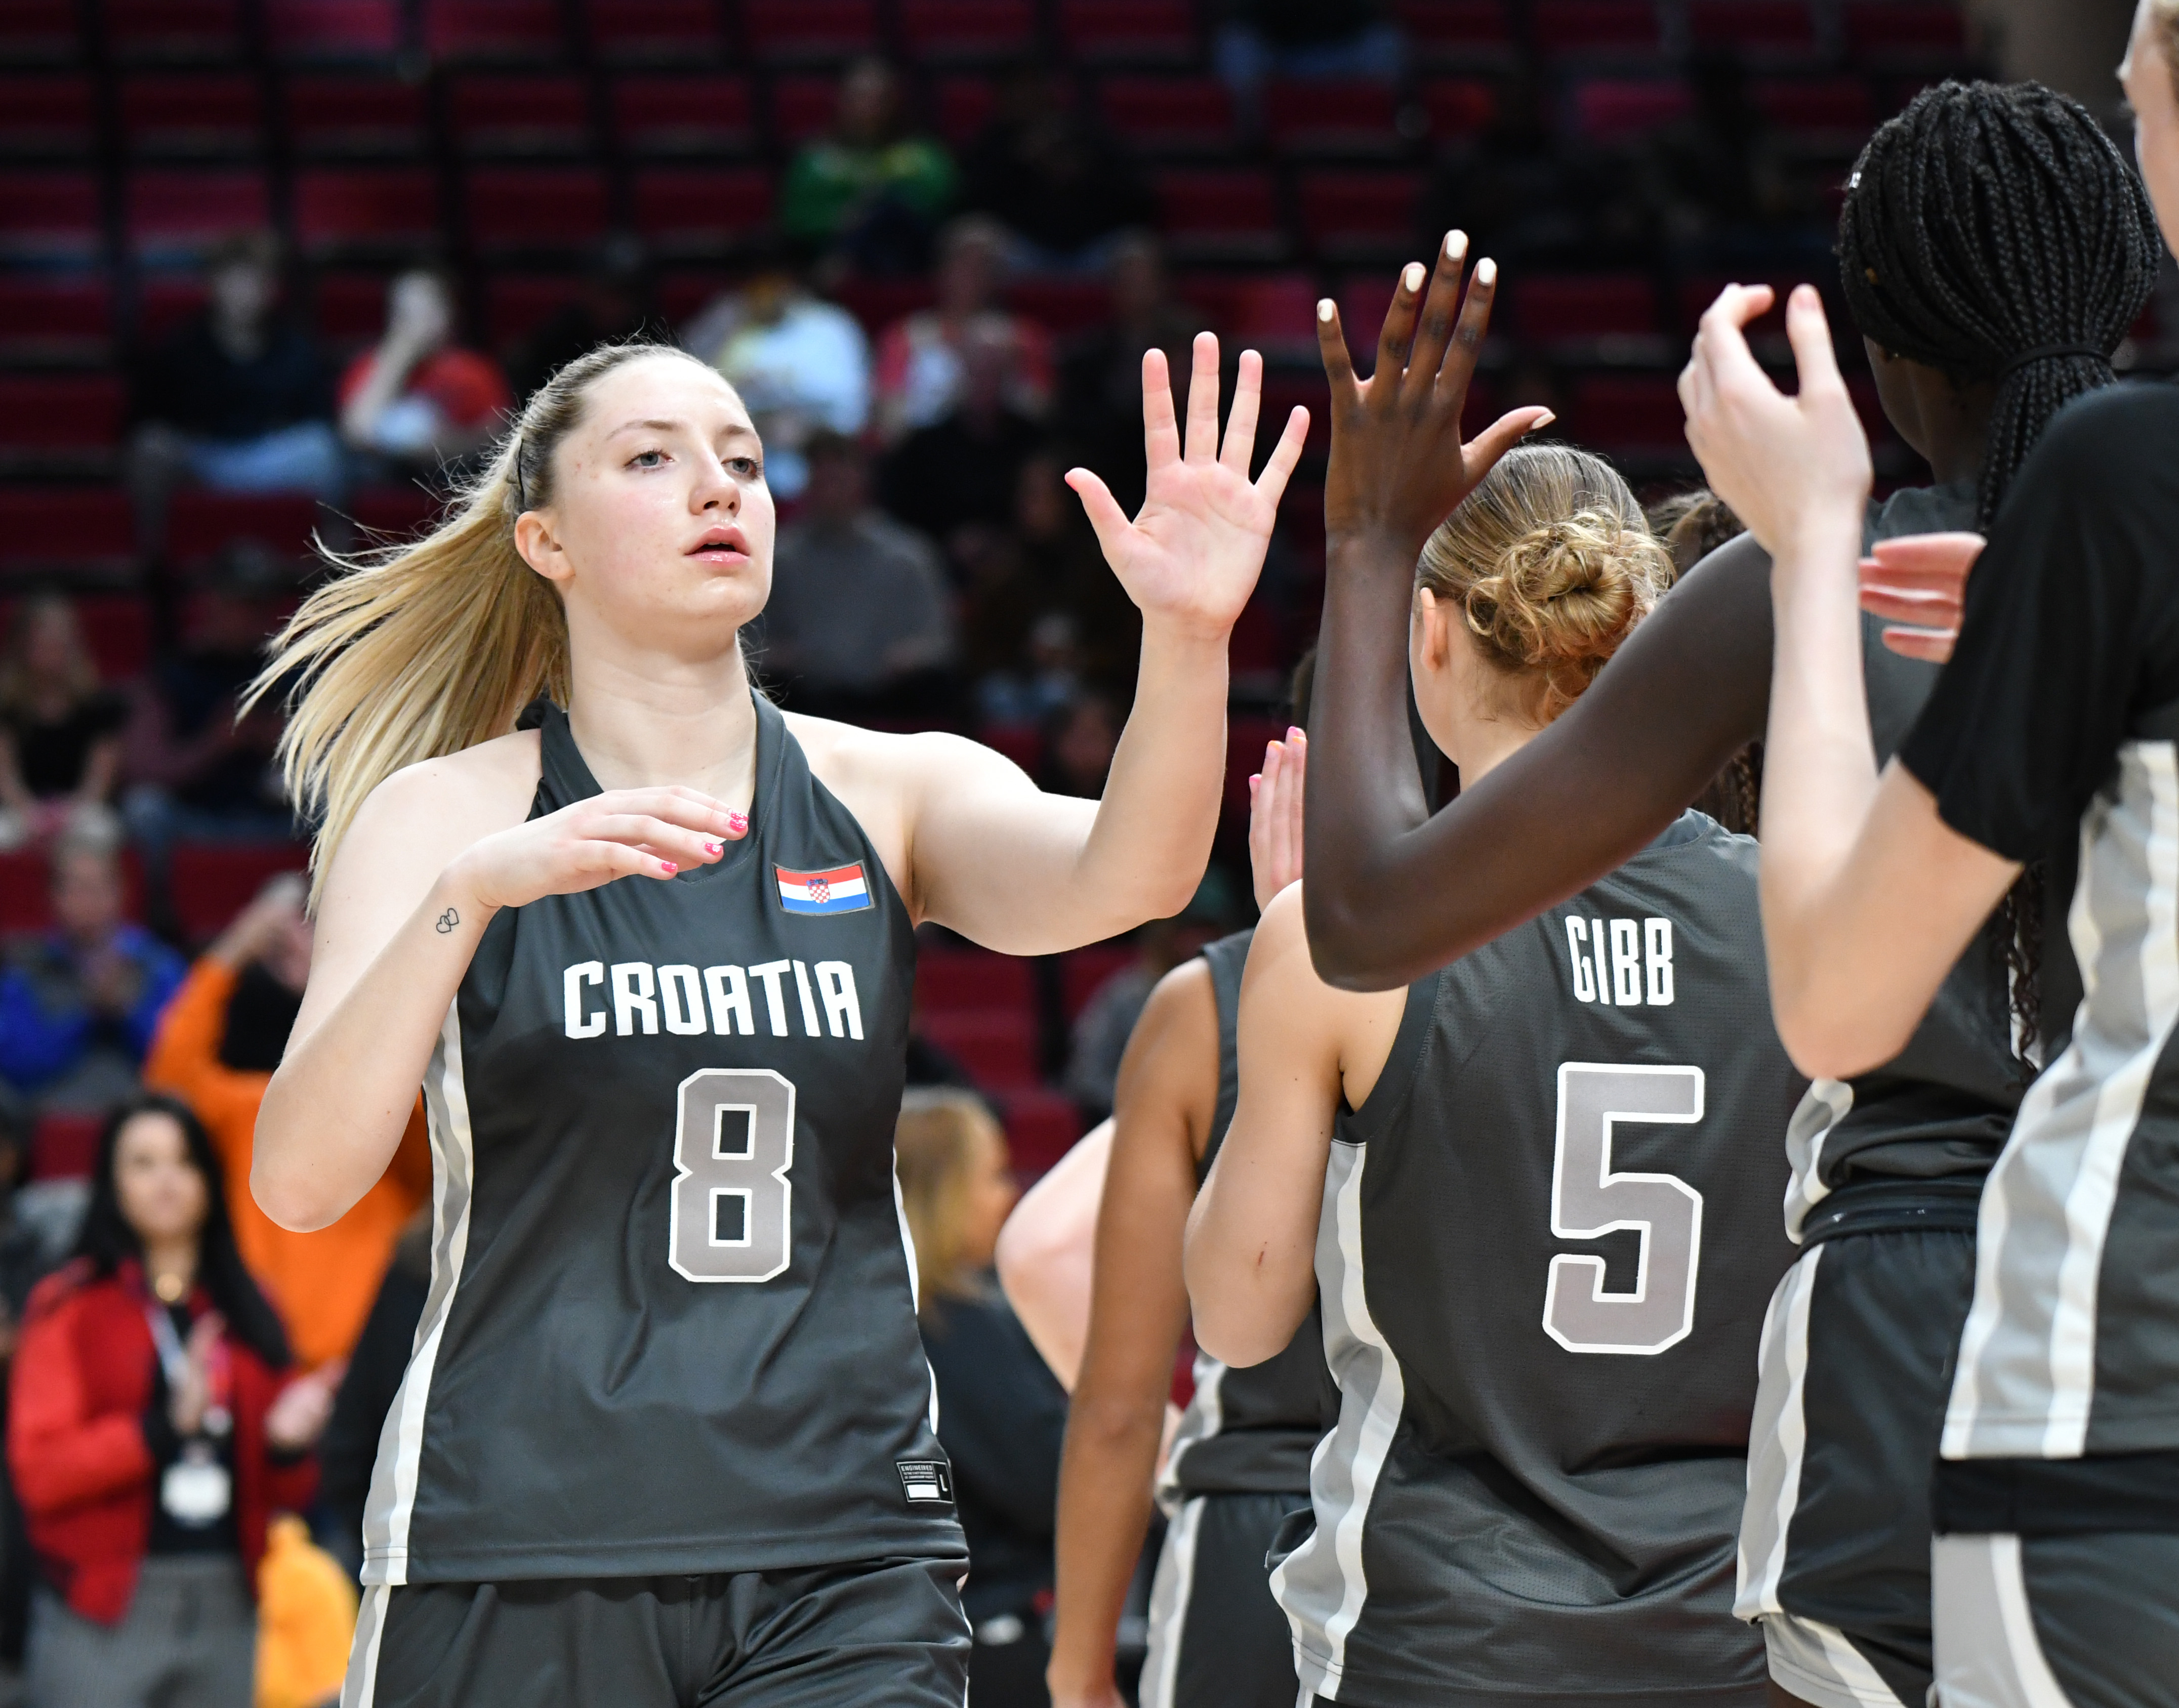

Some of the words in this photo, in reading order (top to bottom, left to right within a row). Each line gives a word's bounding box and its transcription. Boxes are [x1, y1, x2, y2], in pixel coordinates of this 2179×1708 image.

[564, 959, 864, 1040] CROATIA
[1565, 915, 1674, 1006] GIBB
[668, 1068, 796, 1282] 8
[1542, 1062, 1705, 1355] 5
[939, 1474, 948, 1492] L
